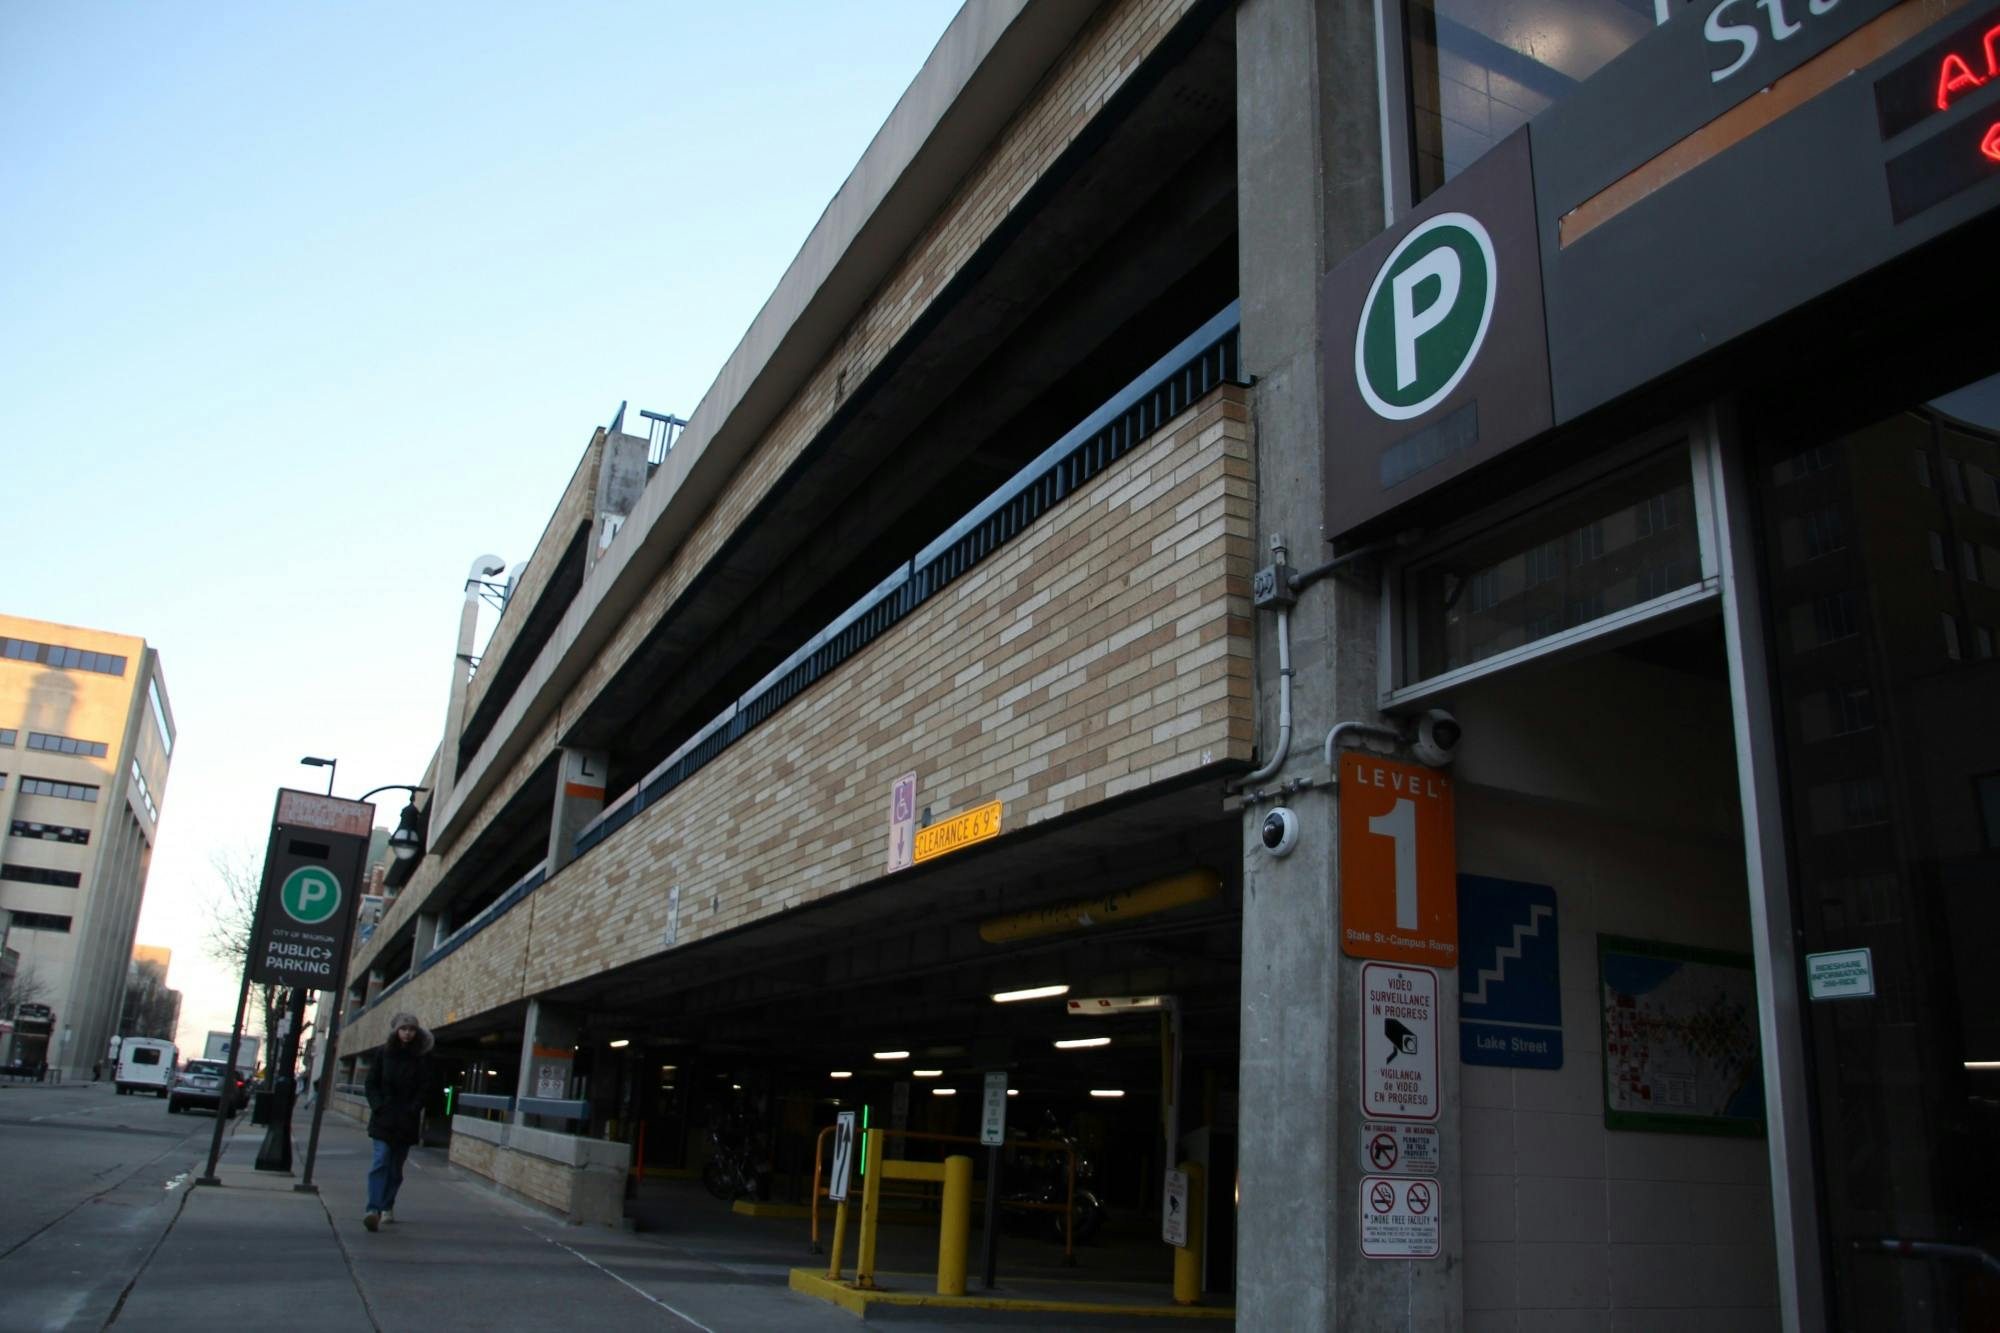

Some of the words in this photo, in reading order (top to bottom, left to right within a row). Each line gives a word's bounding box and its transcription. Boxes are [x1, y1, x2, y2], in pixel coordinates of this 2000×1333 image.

[1393, 246, 1461, 391] P
[581, 756, 594, 777] L
[1357, 765, 1438, 797] LEVEL
[918, 818, 969, 856] CLEARANCE
[1369, 798, 1418, 931] 1
[298, 877, 327, 911] P
[272, 929, 289, 937] CITY
[268, 941, 321, 959] PUBLIC
[1347, 928, 1371, 943] State
[1429, 939, 1455, 957] Ramp
[266, 956, 331, 975] PARKING
[1811, 968, 1867, 980] INFORMATION
[1388, 978, 1412, 991] VIDEO
[1370, 990, 1430, 1007] SURVEILLANCE
[1372, 1004, 1381, 1016] IN
[1385, 1005, 1428, 1020] PROGRESS
[1476, 1034, 1506, 1050] Lake
[1511, 1038, 1549, 1053] Street
[1380, 1068, 1421, 1081] VIGILANCIA
[1384, 1082, 1393, 1091] de
[1396, 1082, 1419, 1093] VIDEO
[1374, 1092, 1385, 1102] EN
[1388, 1093, 1428, 1105] PROGRESO
[1370, 1215, 1389, 1224] SMOKE
[1392, 1215, 1405, 1225] FREE
[1408, 1216, 1430, 1225] FACILITY
